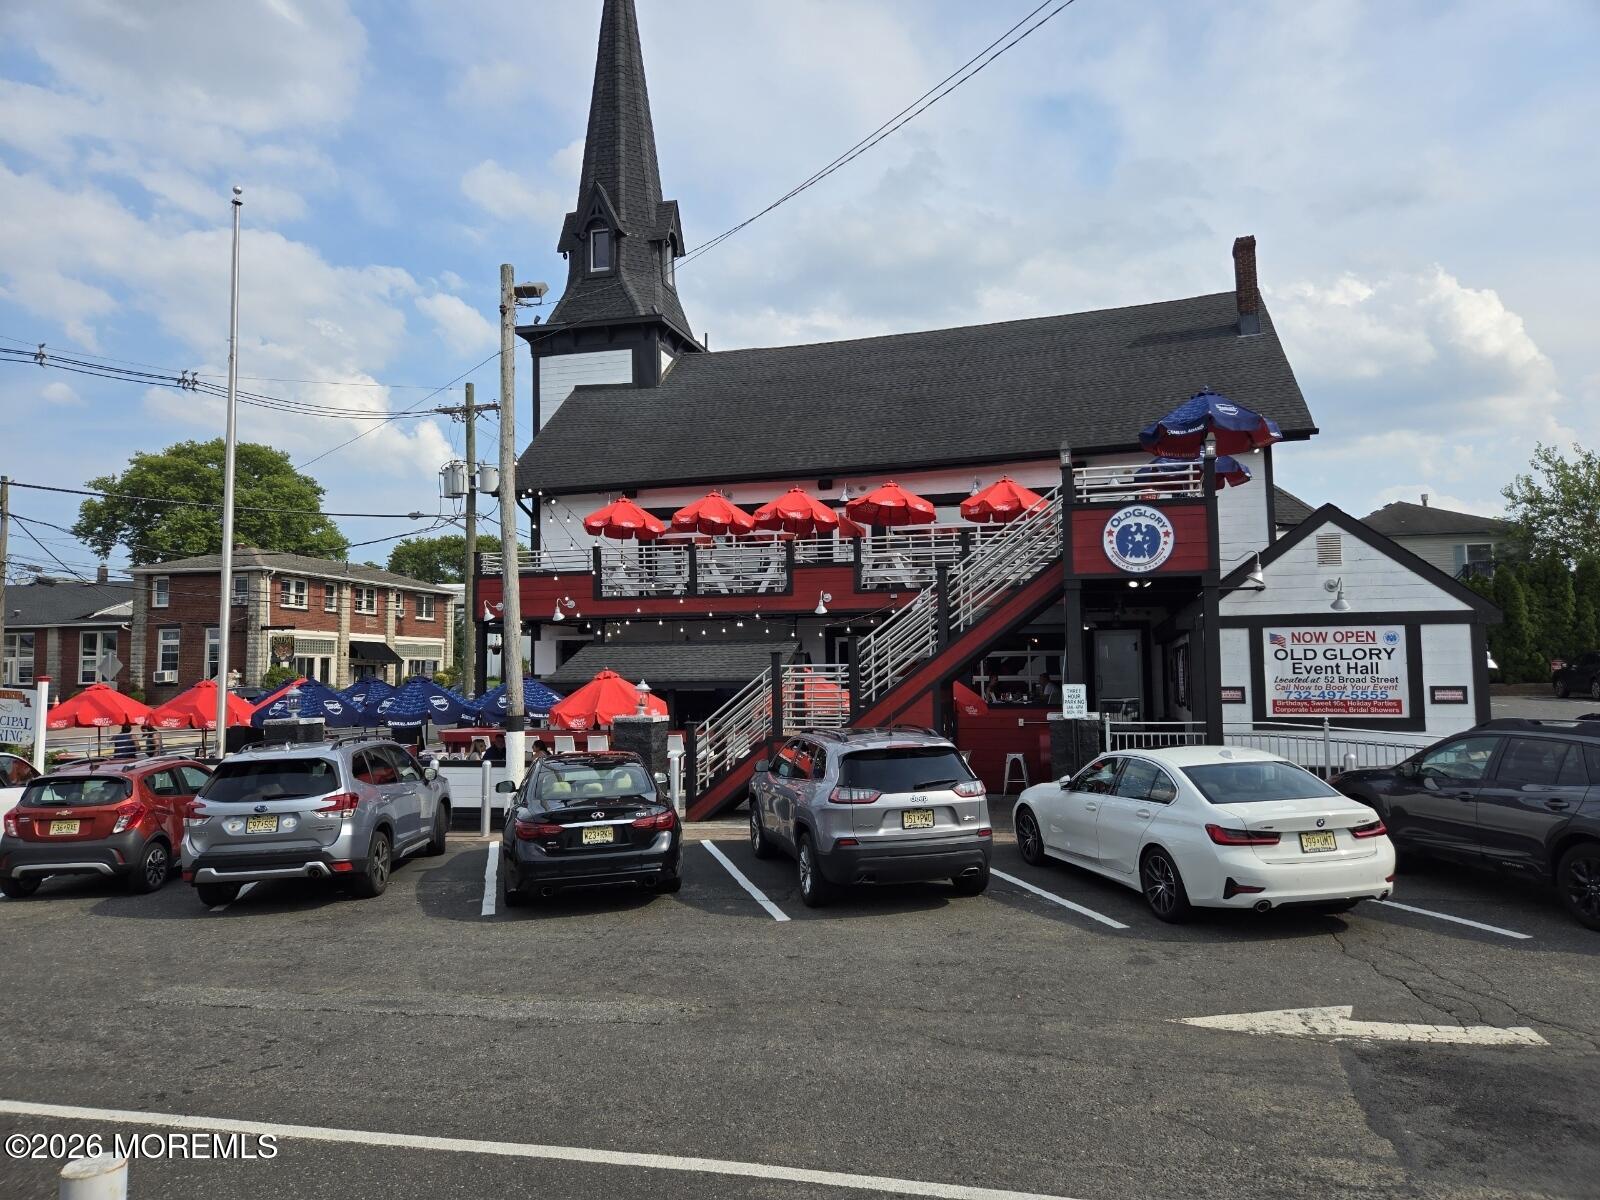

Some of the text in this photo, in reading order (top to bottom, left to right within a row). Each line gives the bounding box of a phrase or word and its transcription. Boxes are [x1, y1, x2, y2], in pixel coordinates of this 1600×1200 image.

[1291, 630, 1376, 643] NOW OPEN
[1274, 647, 1396, 661] OLD GLORY
[1292, 662, 1379, 675] Event Hall
[1274, 676, 1310, 685] Located
[1324, 676, 1335, 684] 52
[1338, 675, 1367, 684] Broad
[1370, 676, 1399, 684] Street
[1284, 690, 1389, 700] 732-497-5555
[1274, 706, 1309, 714] Corporate
